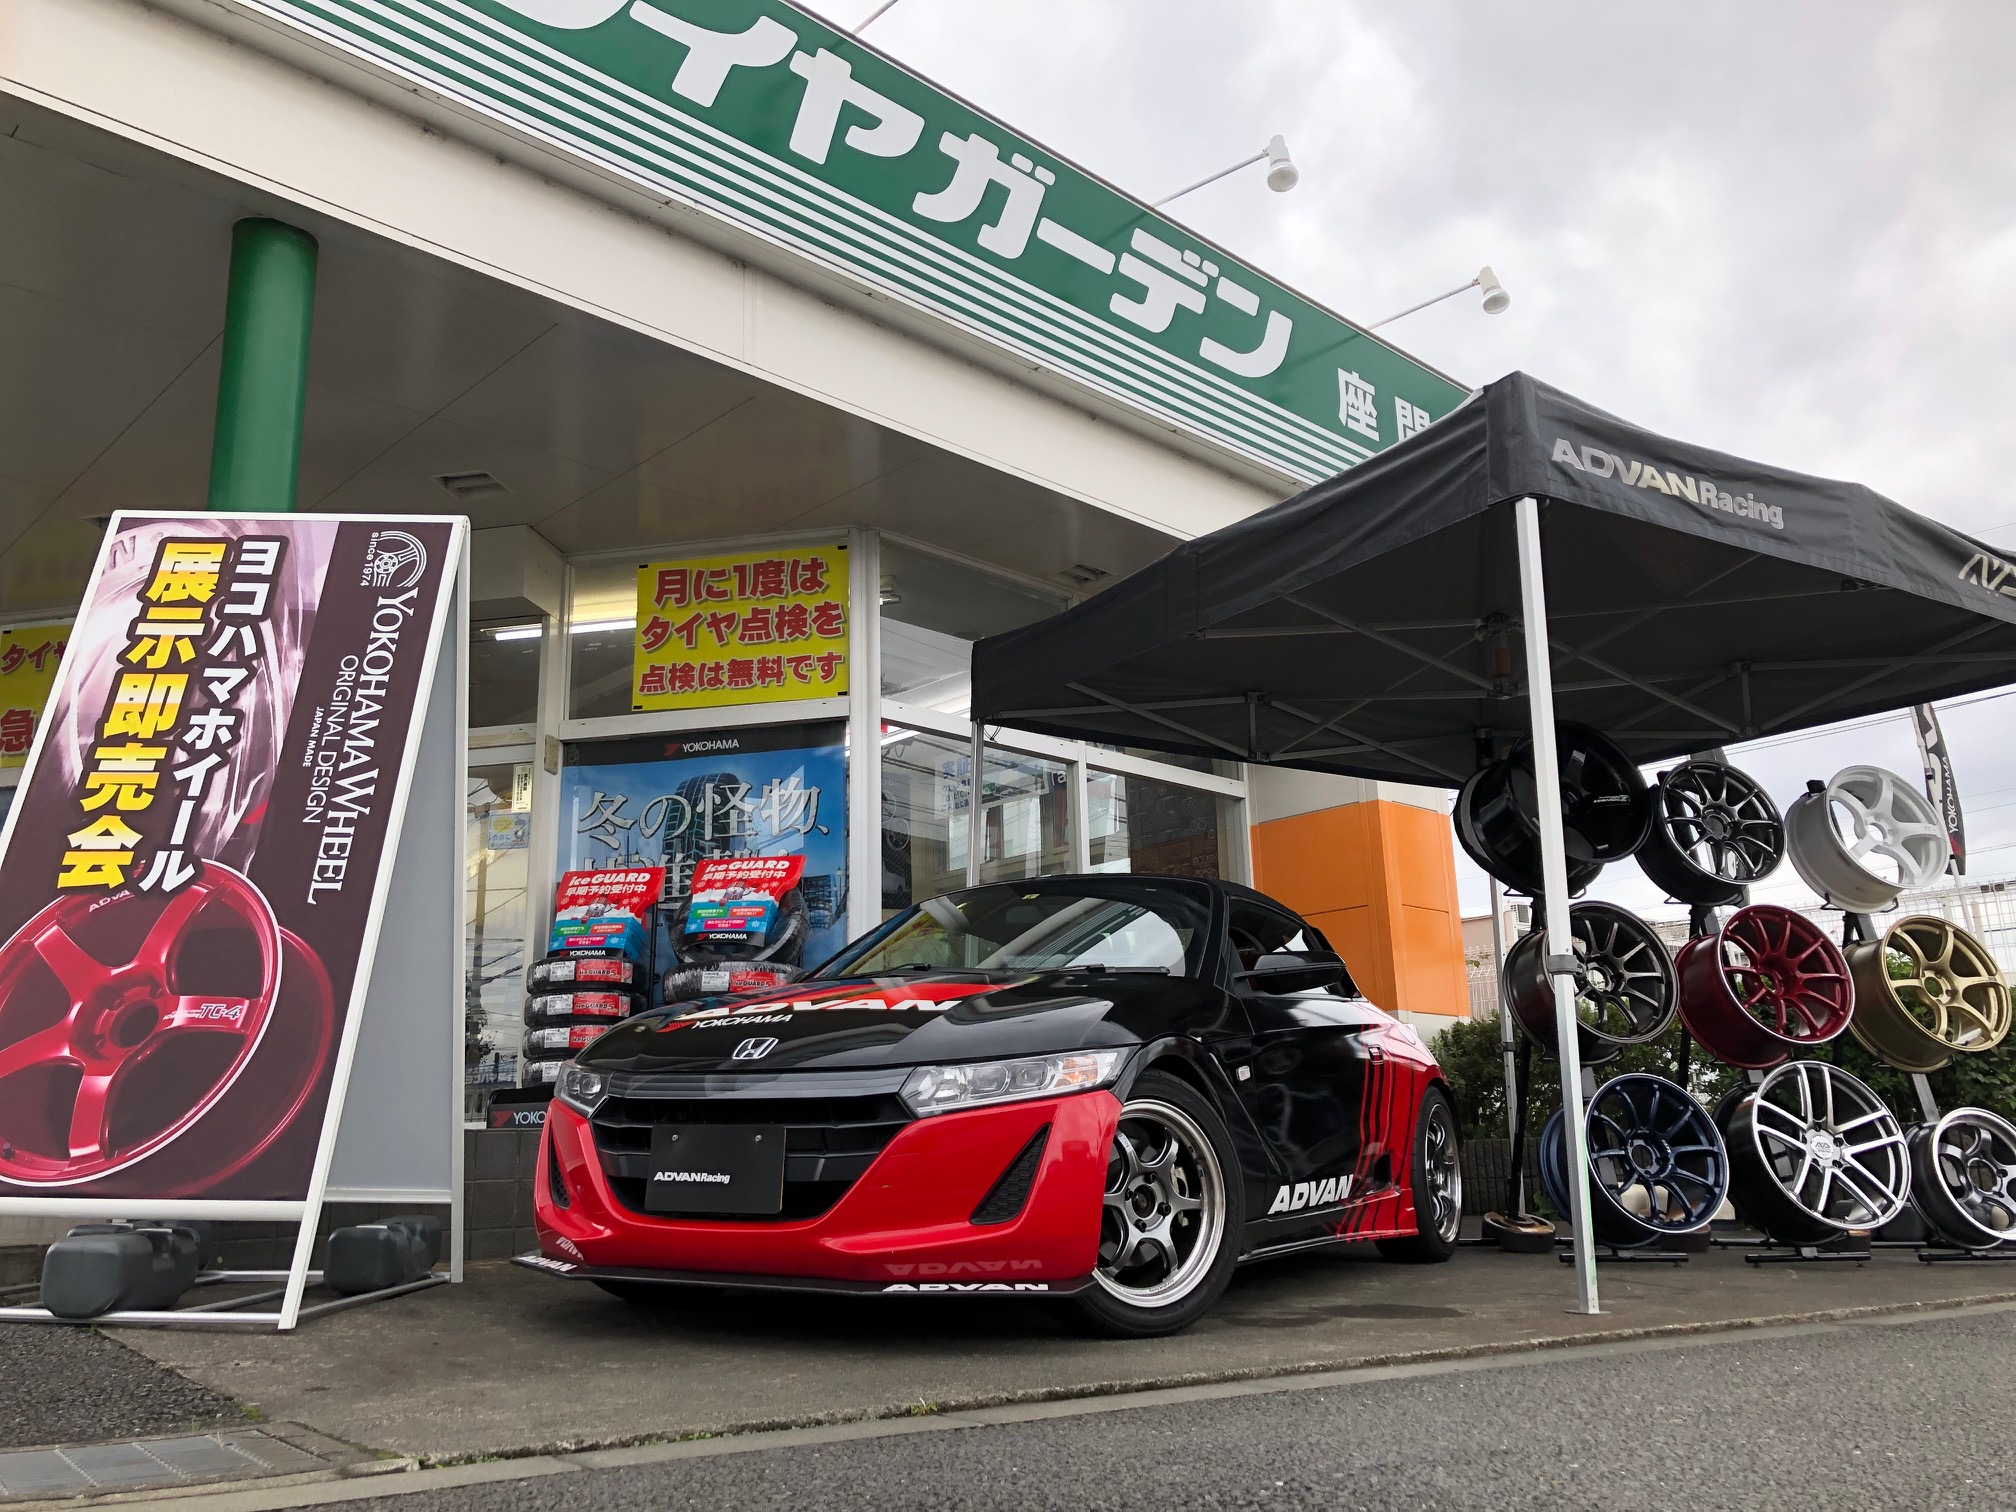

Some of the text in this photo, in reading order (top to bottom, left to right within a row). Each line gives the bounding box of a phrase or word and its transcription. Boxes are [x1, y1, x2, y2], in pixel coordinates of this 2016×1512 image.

[493, 0, 1293, 378] イヤガーデン
[360, 531, 379, 587] since 1974
[654, 556, 827, 606] 月に1度は
[641, 600, 844, 652] タイヤ点検を
[638, 651, 843, 694] 点検は無料です
[57, 541, 227, 890] 展示即売会
[138, 540, 281, 893] ヨコハマホイール
[302, 705, 325, 768] JAPAN MADE
[302, 654, 359, 824] ORIGINAL DESIGN
[682, 738, 740, 753] YOKOHAMA
[1942, 756, 1960, 833] YOKOHAMA
[88, 889, 135, 913] ADVA
[569, 949, 606, 957] YOKOHAMA
[672, 999, 963, 1021] ADVAN
[691, 1013, 794, 1030] YOKOHAMA
[513, 1111, 546, 1125] YOKO
[1267, 1174, 1353, 1216] ADVAN
[517, 1255, 578, 1272] ADVAN
[881, 1283, 1049, 1292] ADVAN
